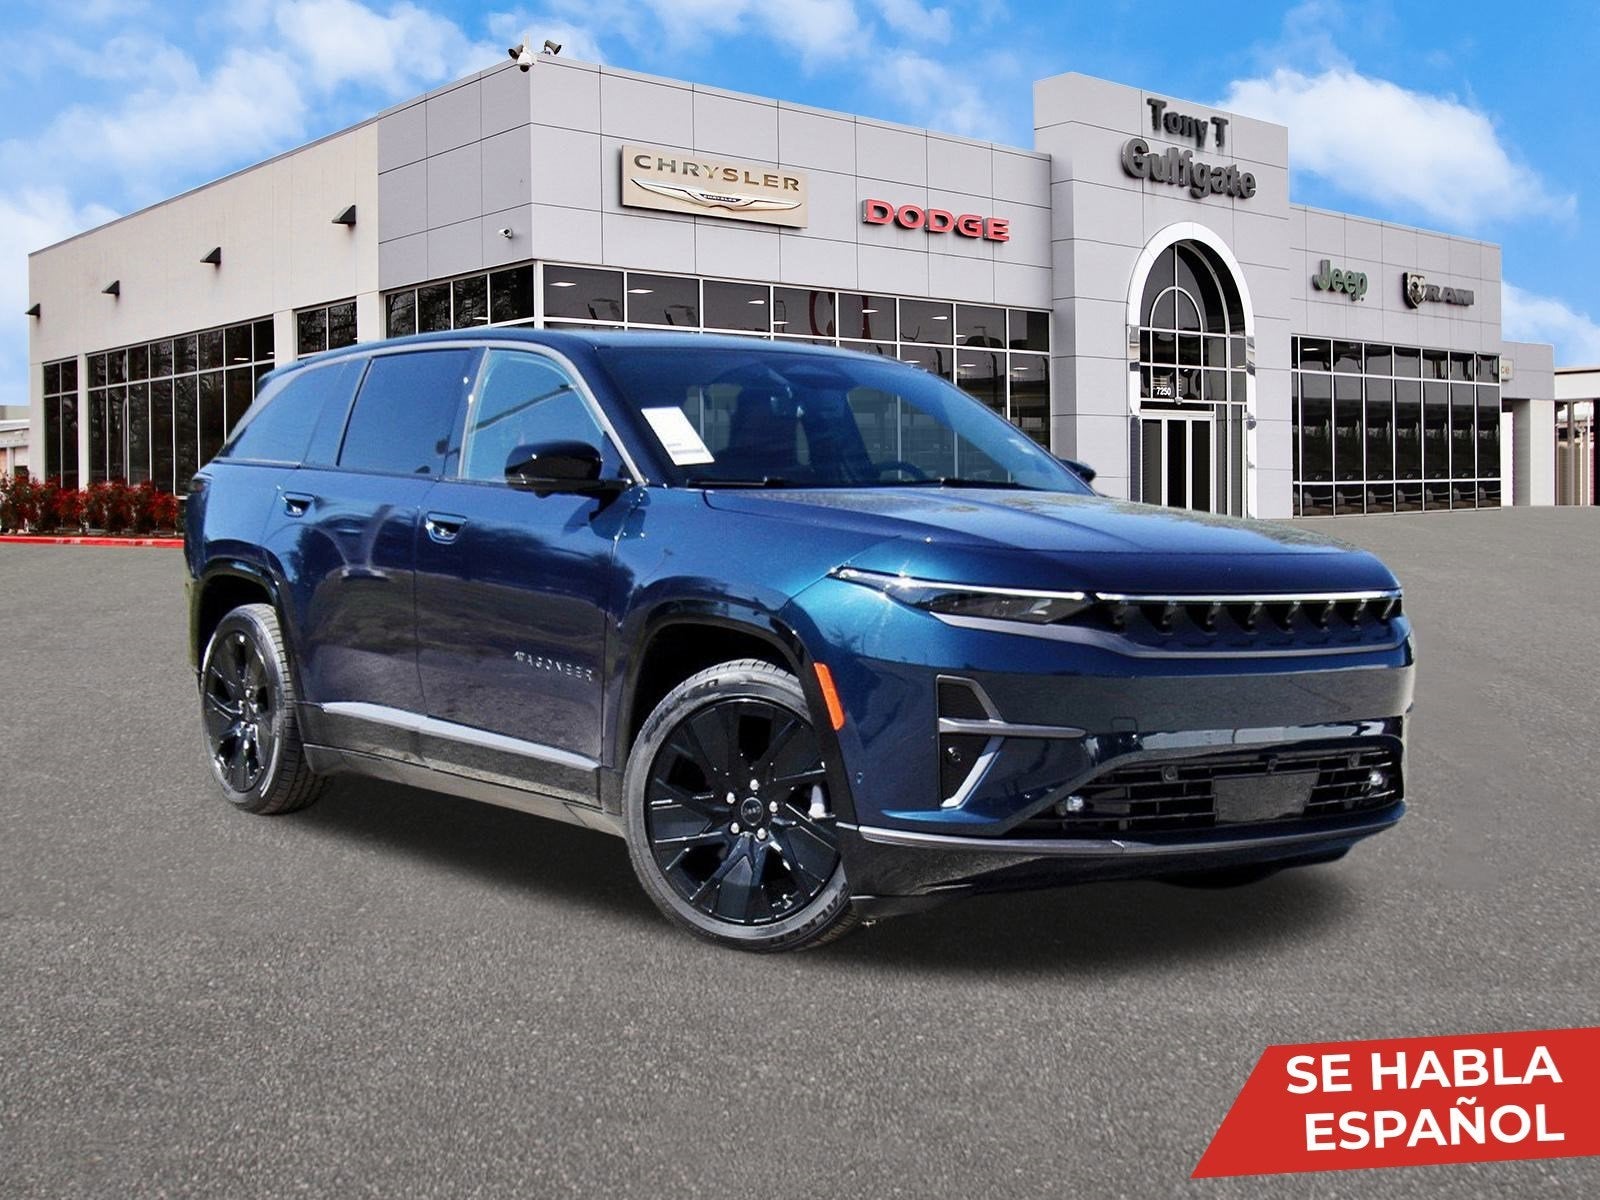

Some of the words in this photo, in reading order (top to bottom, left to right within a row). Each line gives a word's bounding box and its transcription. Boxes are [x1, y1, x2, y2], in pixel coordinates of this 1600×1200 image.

[1147, 98, 1208, 148] Tony
[1210, 117, 1229, 147] T
[633, 153, 800, 192] CHRYSLER
[1121, 138, 1256, 199] Gulfgate
[862, 198, 1010, 243] DODGE
[1311, 259, 1368, 302] Jeep
[1425, 284, 1475, 306] RAM
[1156, 386, 1172, 396] 7250
